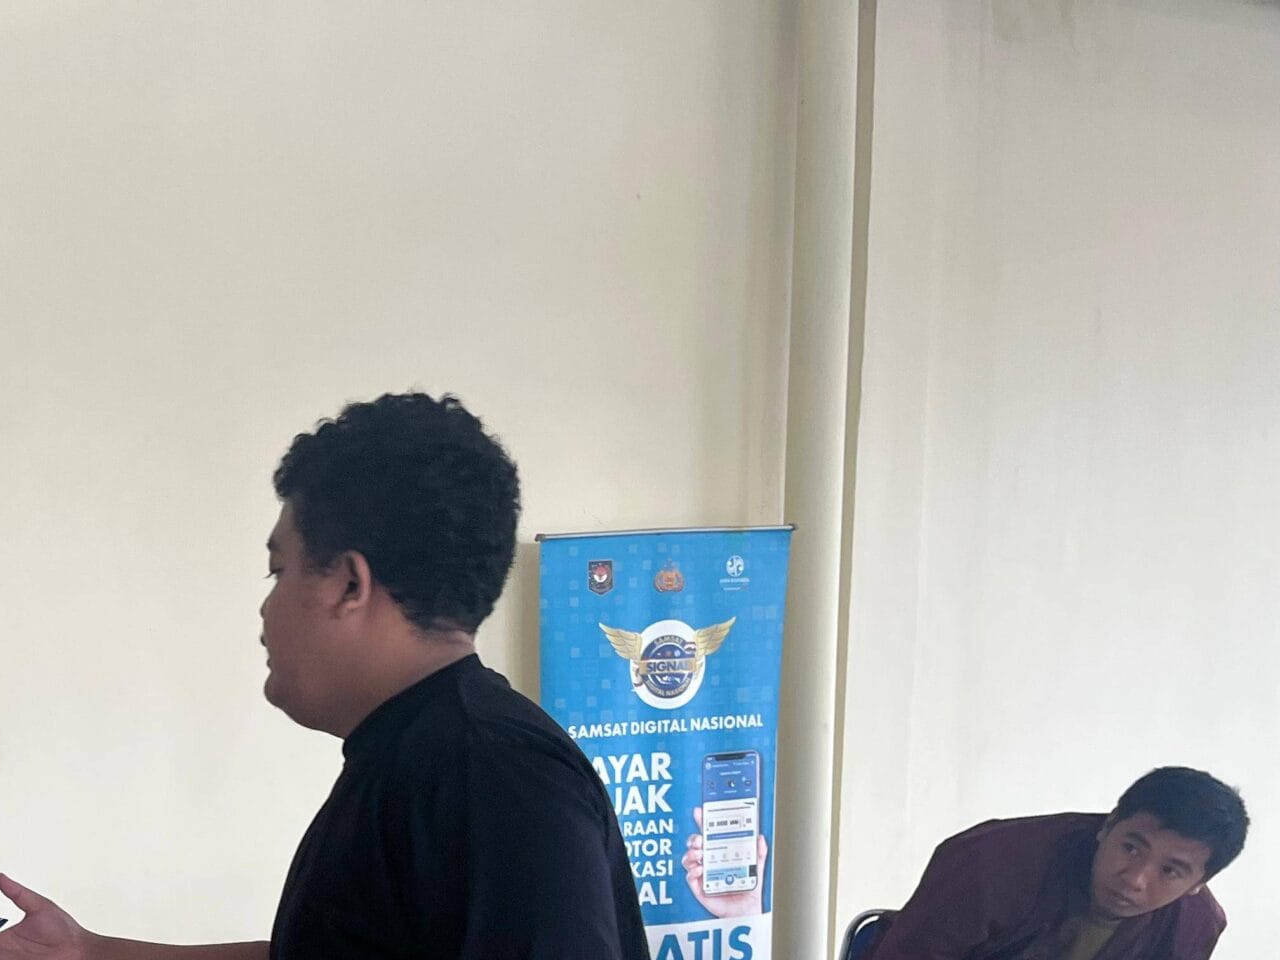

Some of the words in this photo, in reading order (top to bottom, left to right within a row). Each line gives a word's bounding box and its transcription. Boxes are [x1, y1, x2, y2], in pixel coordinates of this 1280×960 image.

[568, 722, 627, 739] SAMSAT
[631, 718, 688, 735] DIGITAL
[690, 714, 763, 731] NASIONAL
[592, 752, 673, 785] AYAR
[623, 818, 673, 837] RAAN
[638, 880, 673, 906] AL
